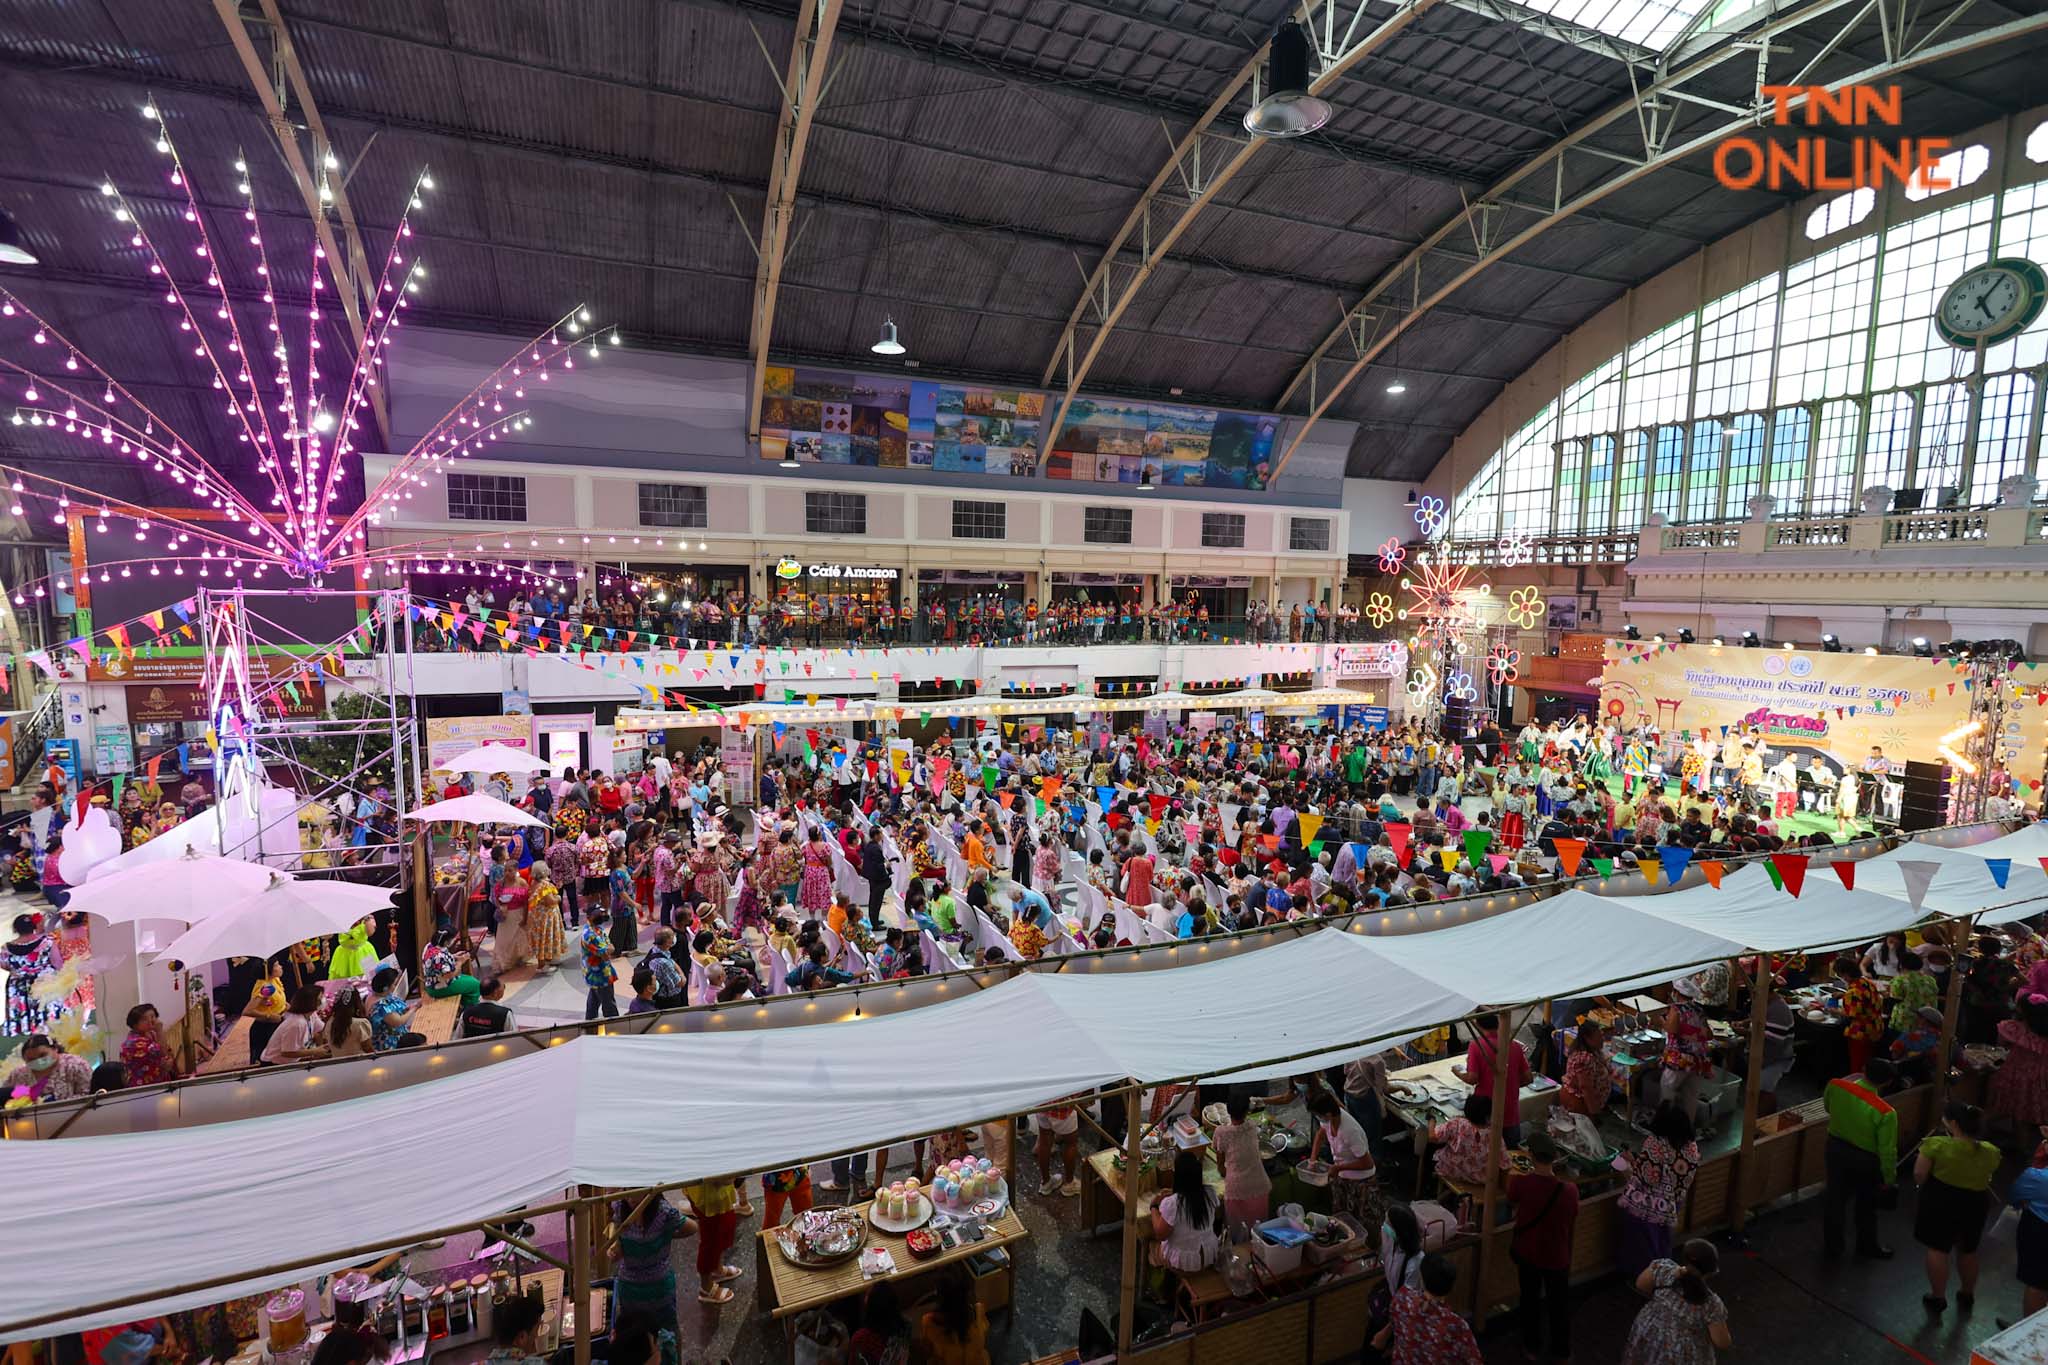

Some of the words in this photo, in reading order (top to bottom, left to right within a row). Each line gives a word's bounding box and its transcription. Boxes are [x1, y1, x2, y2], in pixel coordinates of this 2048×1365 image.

[809, 564, 841, 578] Café
[844, 566, 898, 579] Amazon
[1868, 688, 1911, 702] 2566
